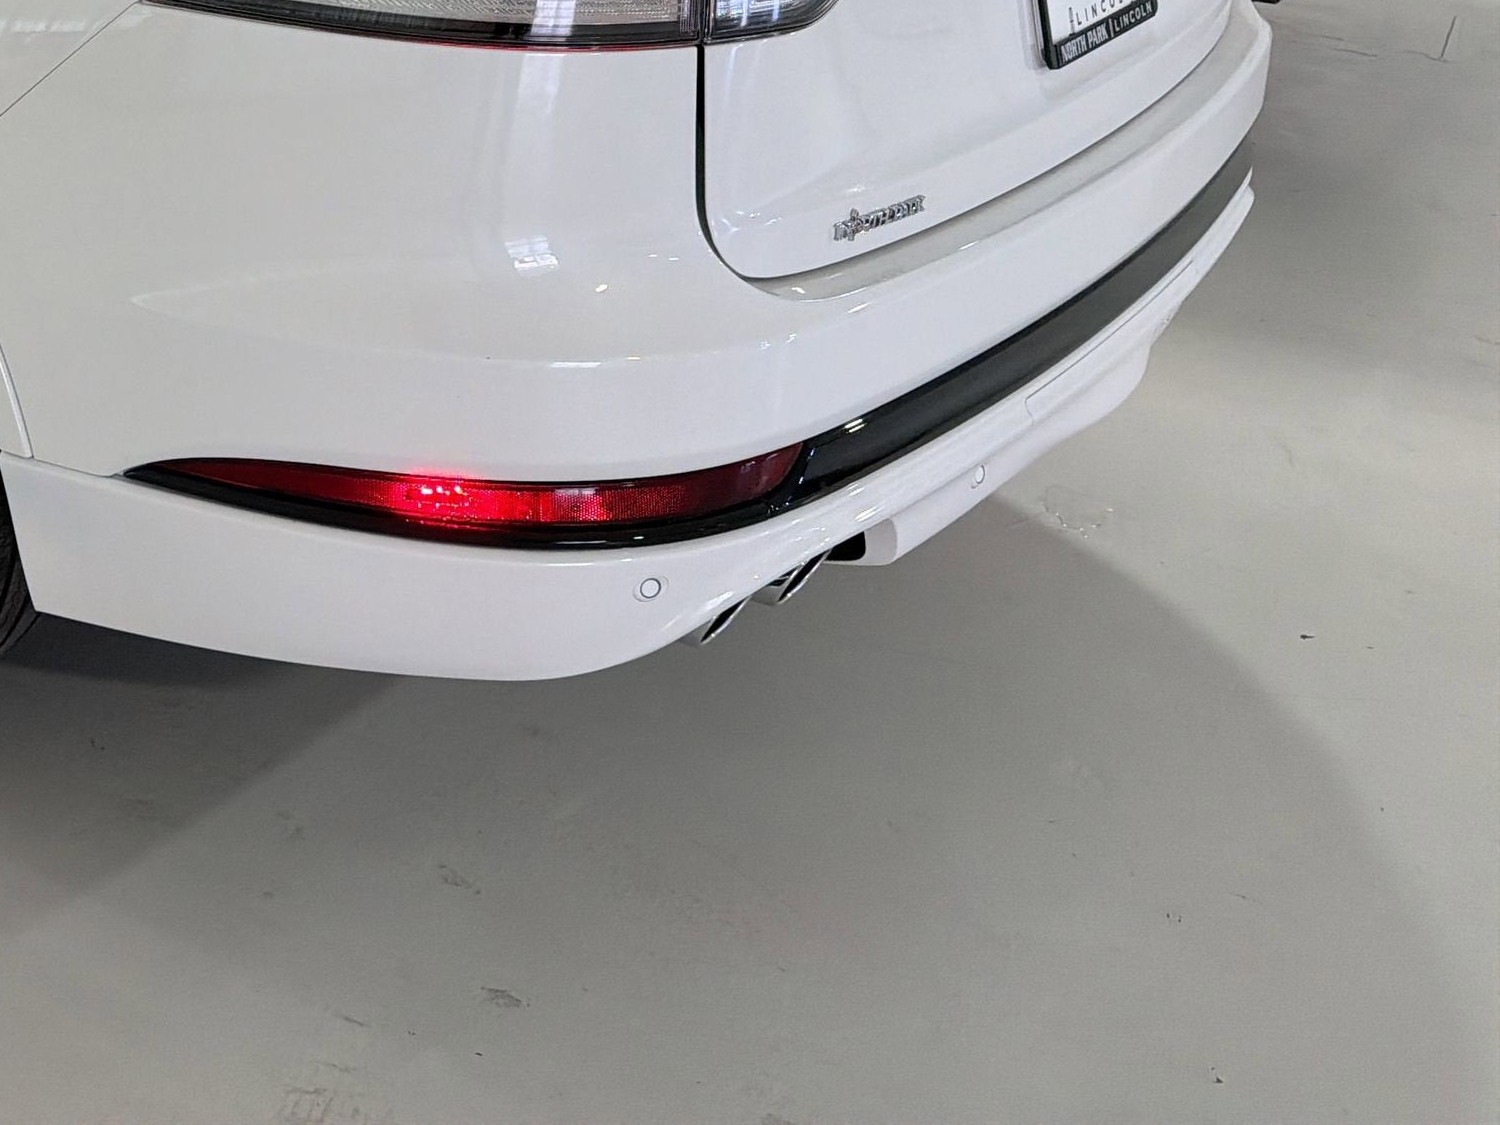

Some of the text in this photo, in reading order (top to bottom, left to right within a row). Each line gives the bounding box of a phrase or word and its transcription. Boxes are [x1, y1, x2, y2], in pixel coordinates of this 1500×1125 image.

[1060, 0, 1152, 63] NORTH PARK LINCOLN
